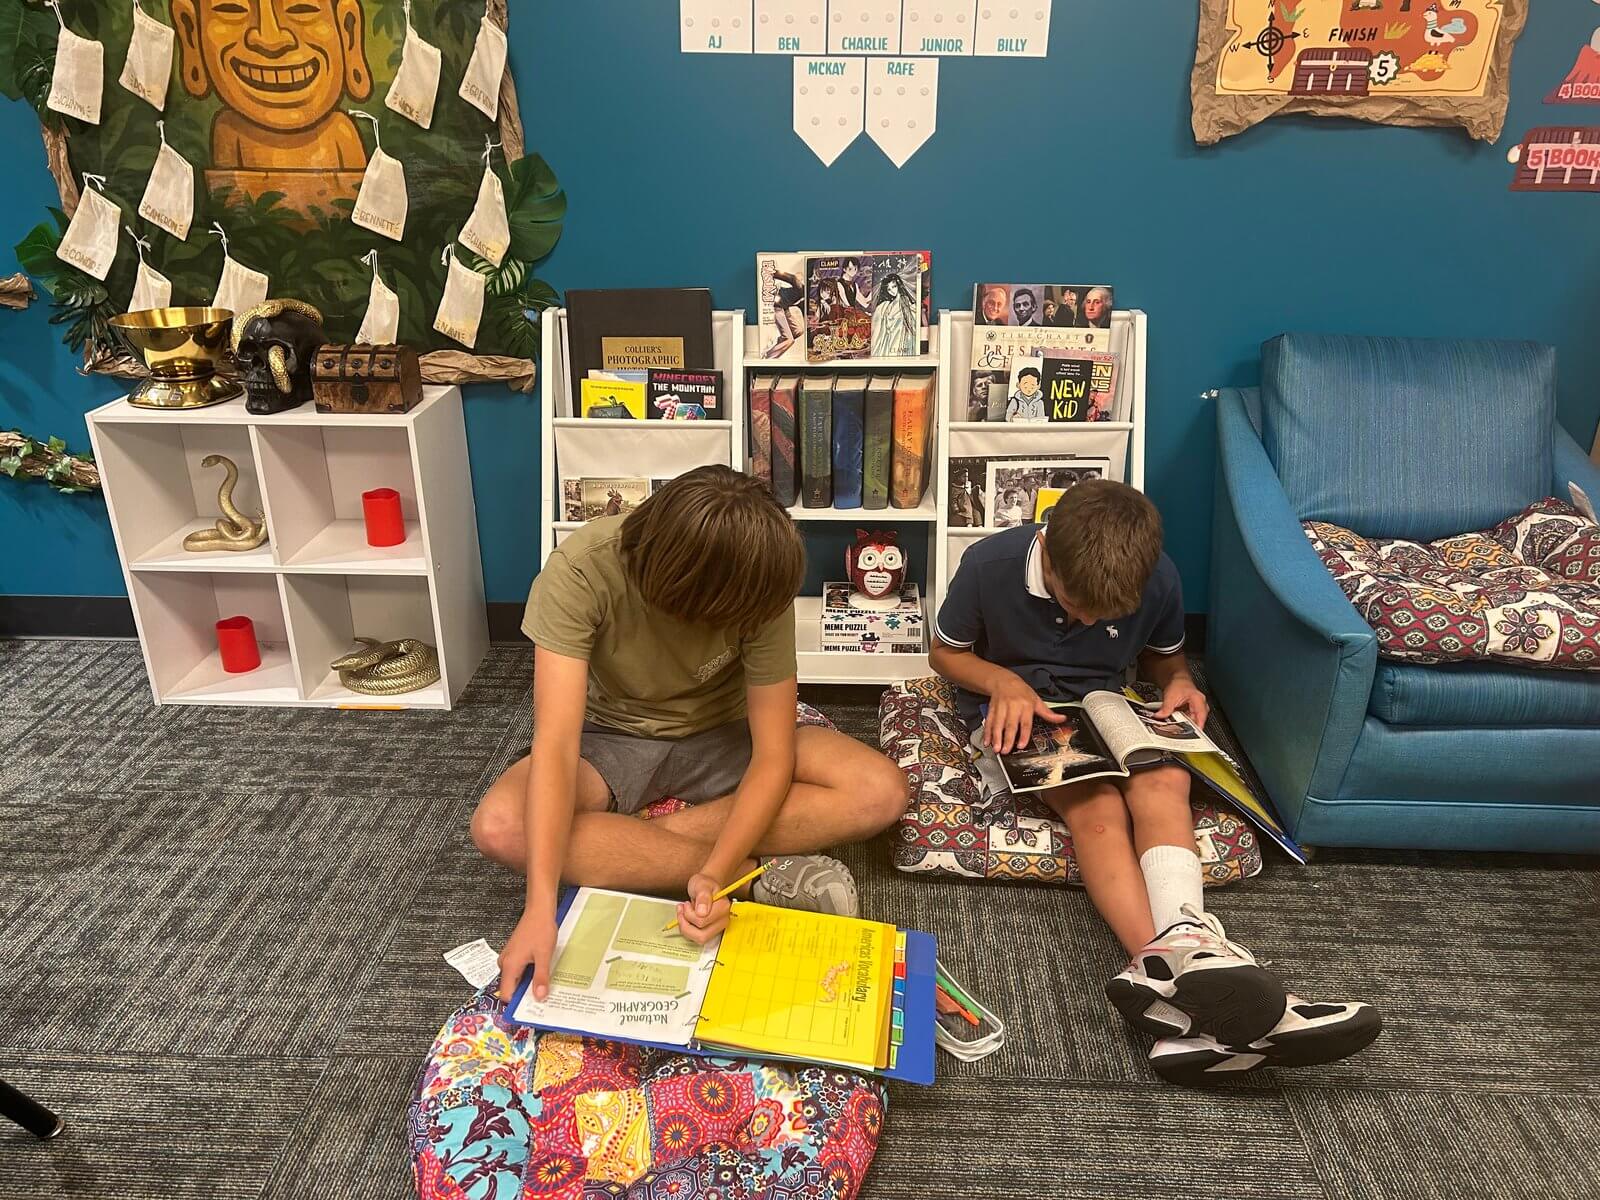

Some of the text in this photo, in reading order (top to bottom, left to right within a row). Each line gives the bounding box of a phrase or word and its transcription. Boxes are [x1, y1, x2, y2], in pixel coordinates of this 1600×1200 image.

[1328, 27, 1378, 42] FINISH
[708, 35, 722, 49] AJ
[778, 37, 800, 51] BEN
[841, 37, 888, 51] CHARLIE
[920, 38, 963, 52] JUNIOR
[997, 38, 1028, 52] BILLY
[808, 62, 847, 76] MCKAY
[887, 62, 915, 76] RAFE
[1376, 60, 1389, 77] 5
[1560, 84, 1571, 98] 4
[1528, 148, 1543, 167] 5
[144, 203, 179, 234] CAMERON
[358, 211, 396, 234] BENNETT
[820, 260, 839, 268] CLAMP
[1001, 330, 1080, 341] TIMECHART
[624, 345, 662, 354] COLLIER'S
[607, 355, 680, 365] PHOTOGRAPHIC
[653, 383, 715, 394] THE MOUNTAIN
[1050, 379, 1086, 400] NEW
[824, 623, 867, 631] MEME PUZZLE
[851, 927, 876, 1003] Americas Vocabulary
[609, 1000, 679, 1014] GEOGRAPHIC
[619, 1013, 668, 1026] National
